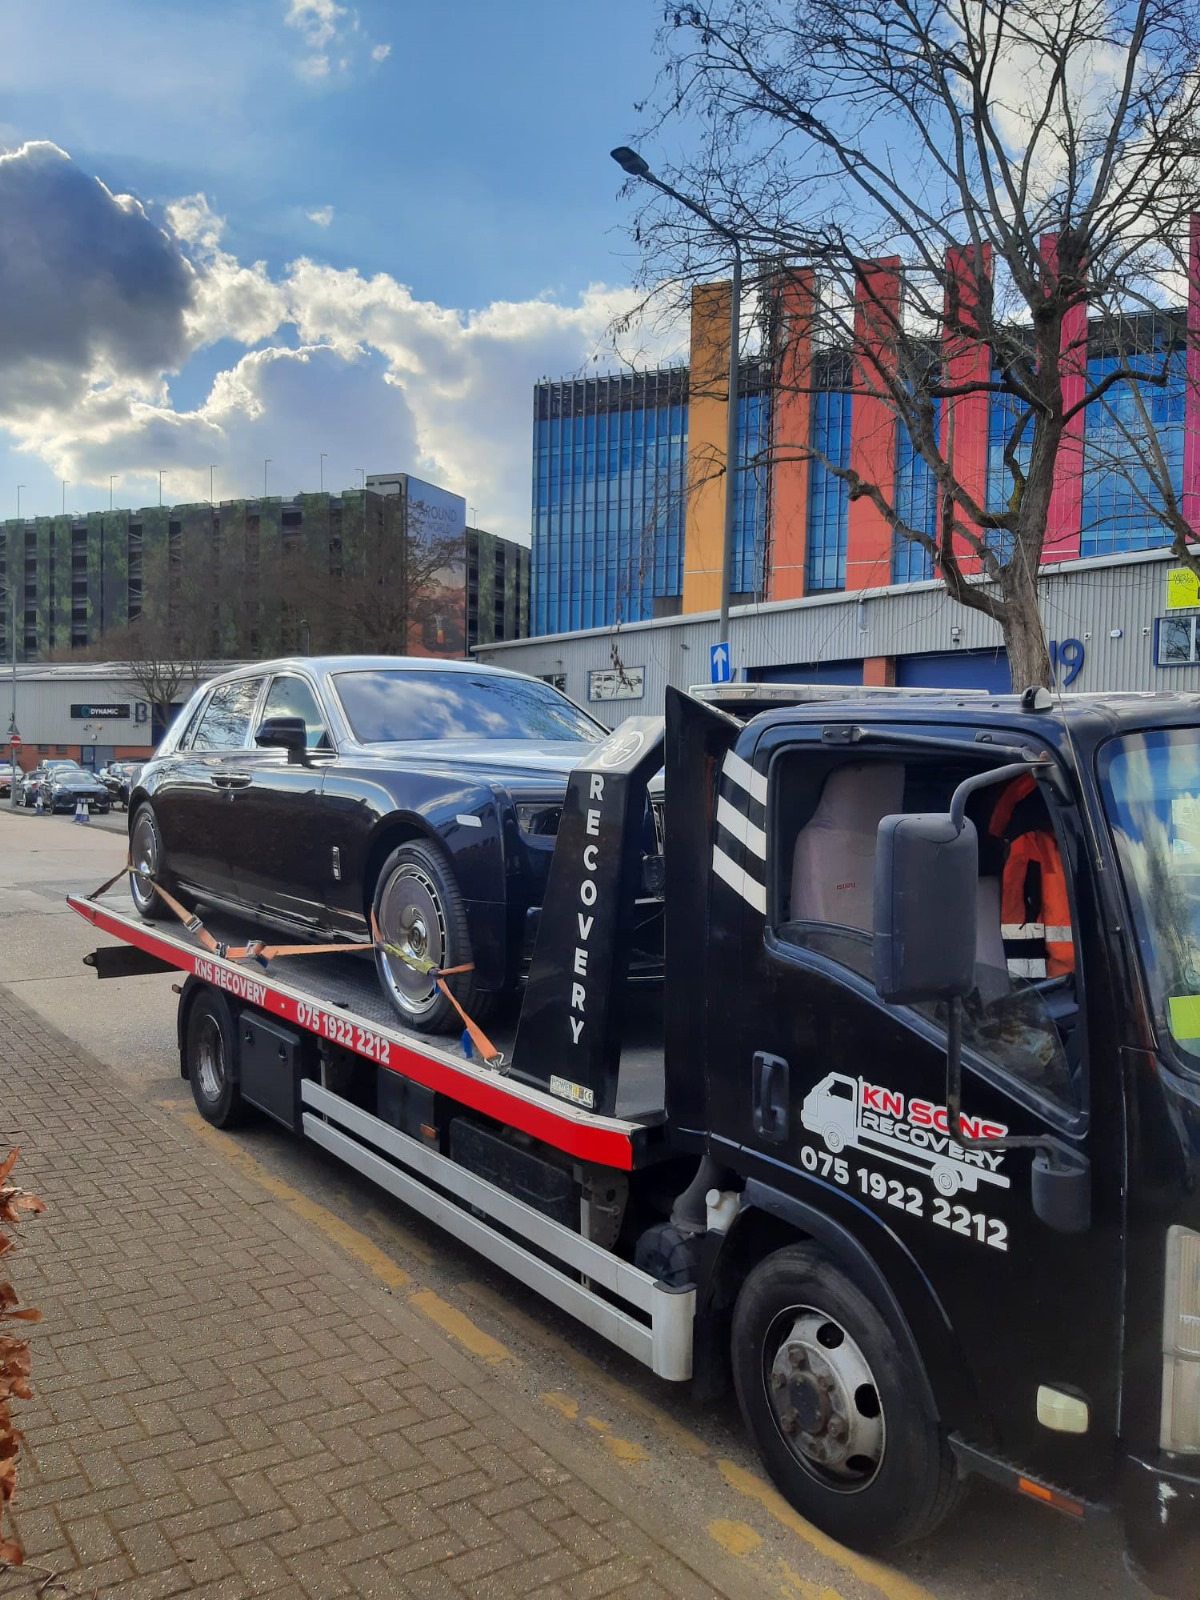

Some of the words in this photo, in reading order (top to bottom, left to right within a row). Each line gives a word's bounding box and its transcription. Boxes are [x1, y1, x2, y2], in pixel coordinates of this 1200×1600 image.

[90, 708, 119, 716] DYNAMIC
[135, 702, 148, 723] B
[569, 773, 605, 1045] RECOVERY
[194, 957, 213, 982] KNS
[214, 965, 267, 1006] RECOVERY
[297, 1002, 320, 1031] 075
[322, 1013, 353, 1047] 1922
[356, 1029, 391, 1065] 2212
[861, 1084, 903, 1118] KN
[862, 1111, 1005, 1172] RECOVERY
[801, 1145, 850, 1185] 075
[856, 1168, 923, 1217] 1922
[932, 1198, 1008, 1251] 2212
